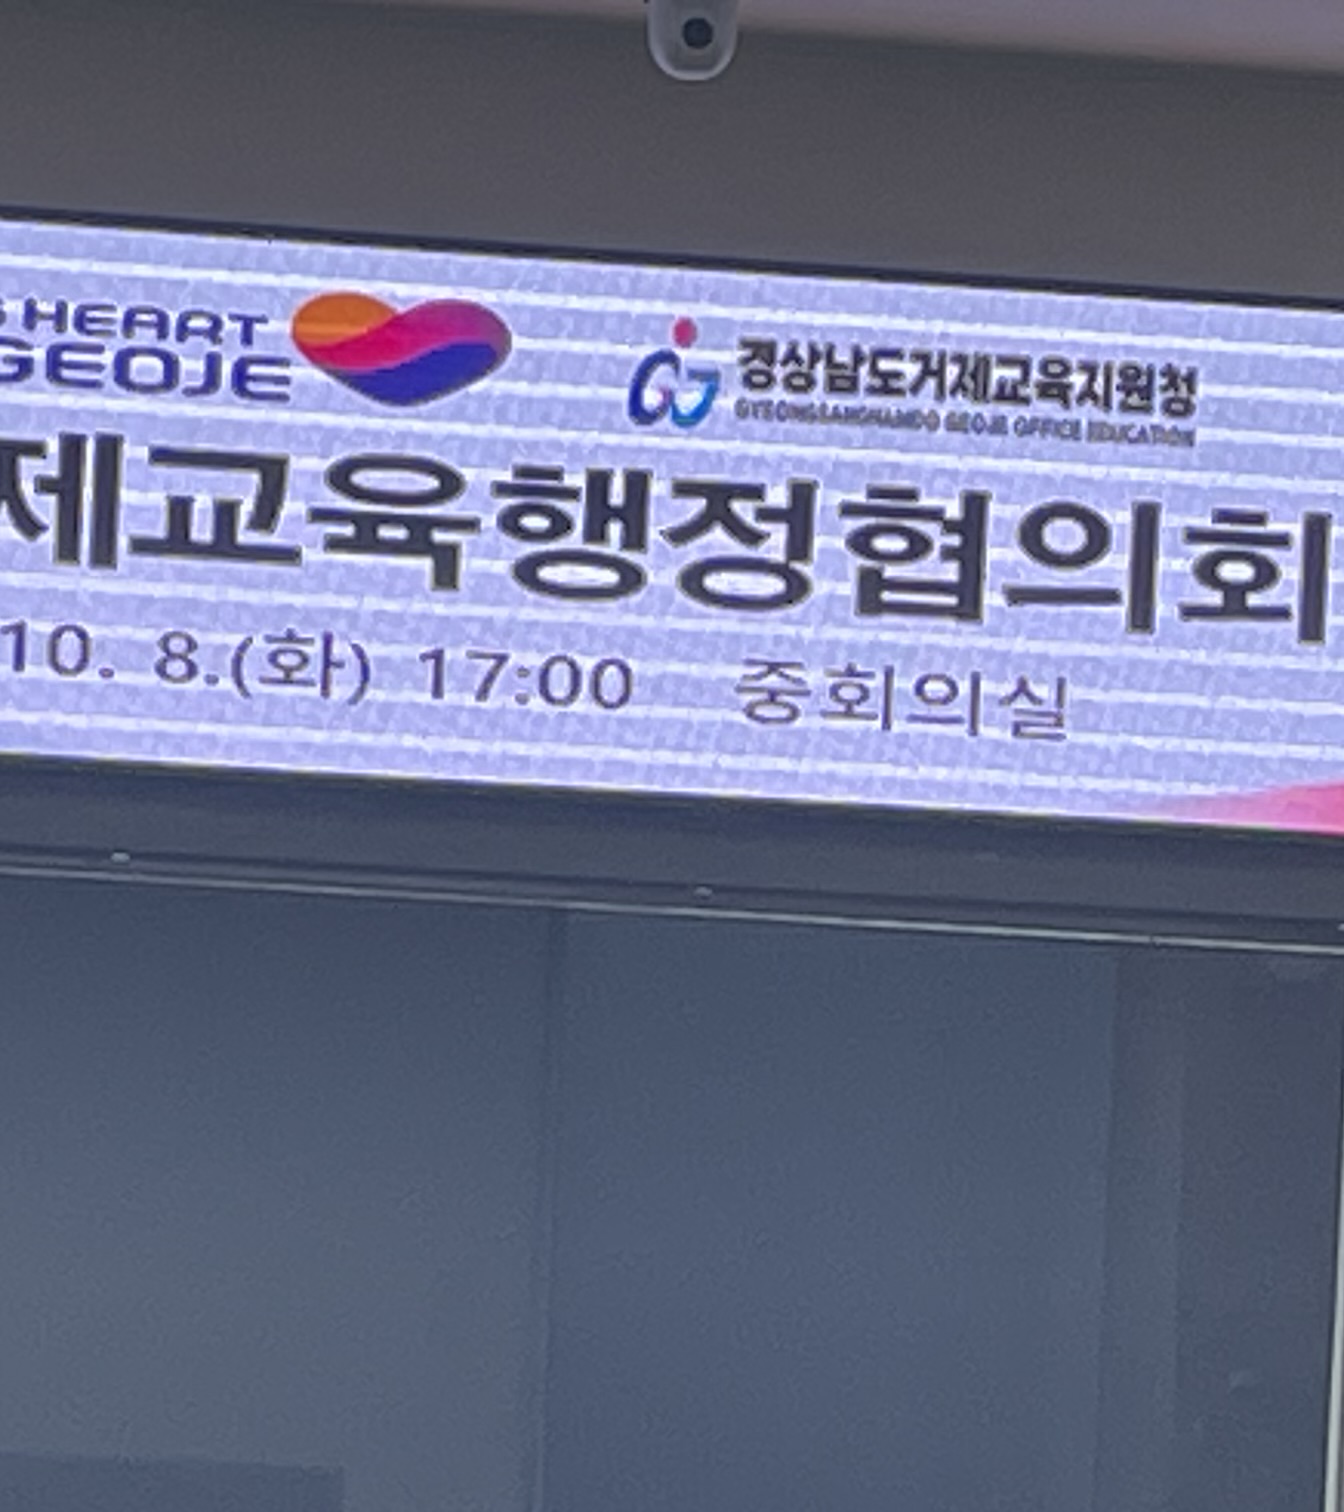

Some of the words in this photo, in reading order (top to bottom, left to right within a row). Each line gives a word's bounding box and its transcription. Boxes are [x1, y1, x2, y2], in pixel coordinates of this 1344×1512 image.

[22, 298, 269, 346] HEART
[738, 337, 1200, 419] 경상남도거제교육지원청
[0, 620, 118, 681] 10.
[151, 627, 374, 706] 8.(화)
[418, 646, 635, 710] 17:00
[734, 660, 1070, 741] 중회의실
